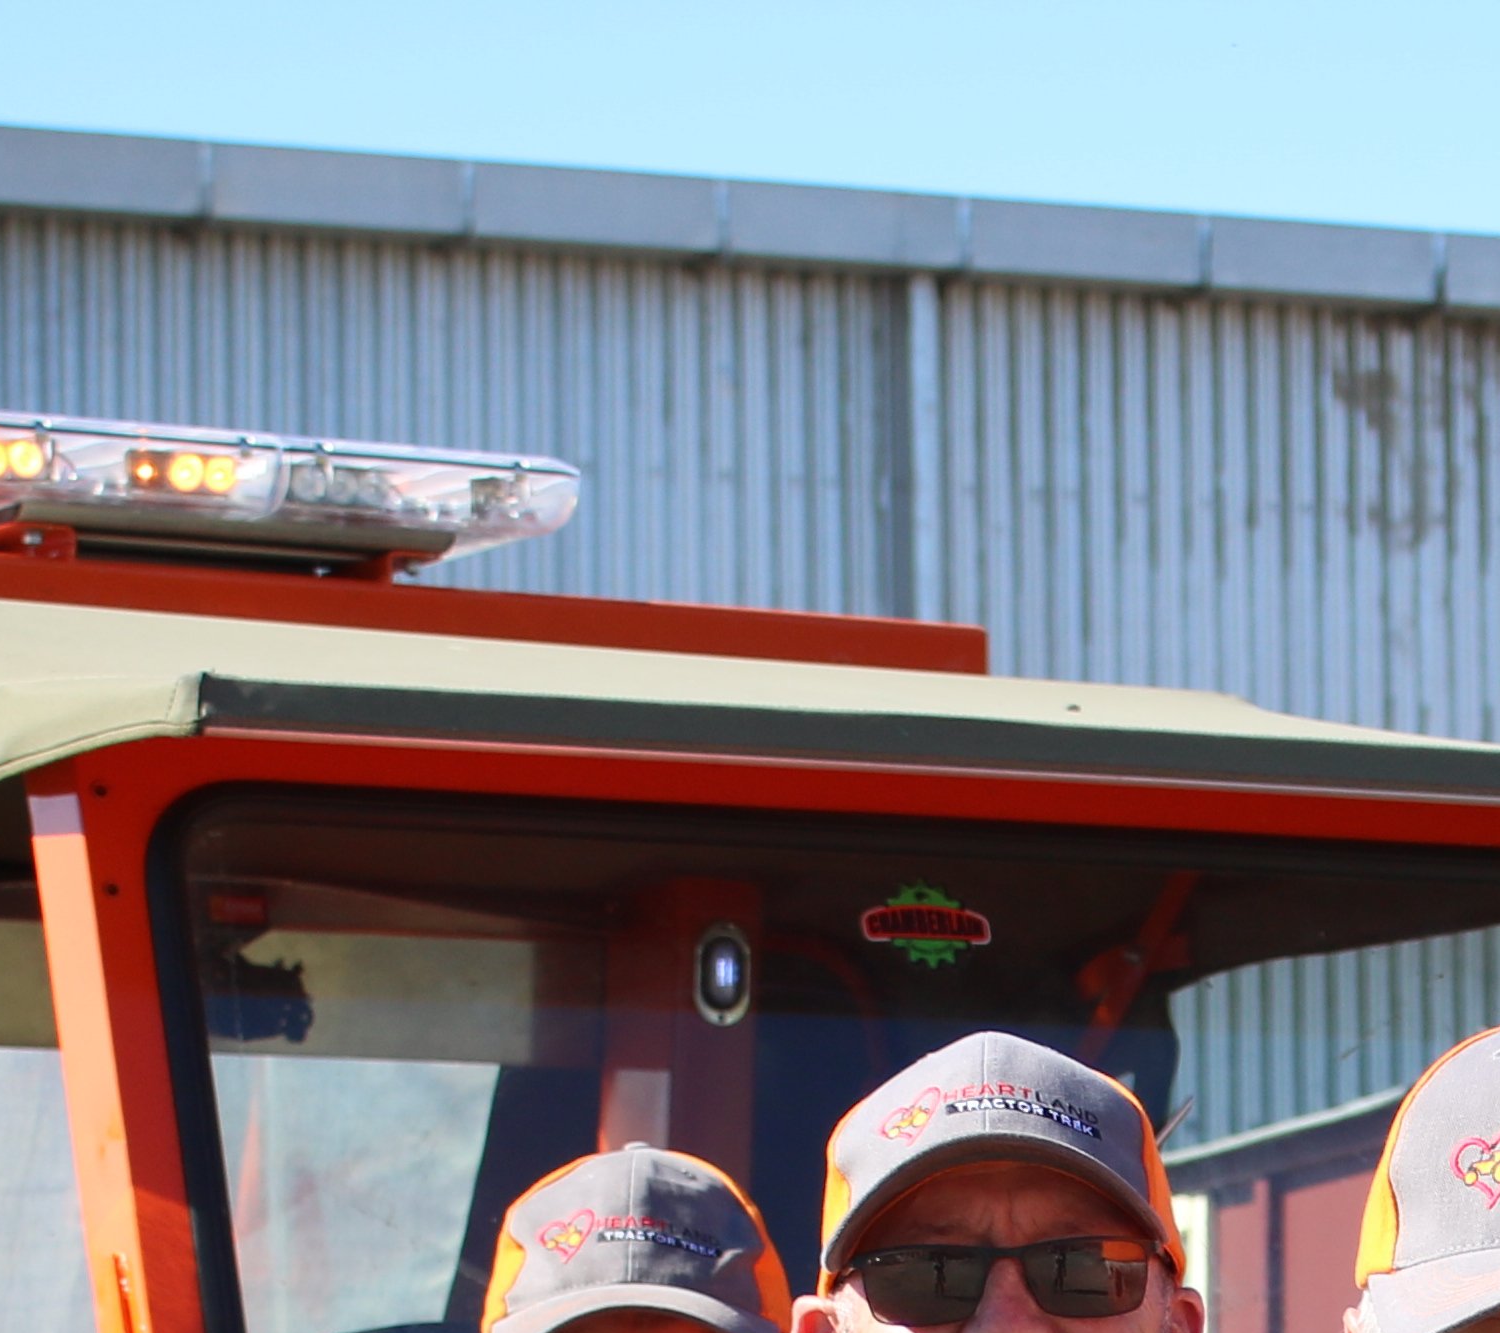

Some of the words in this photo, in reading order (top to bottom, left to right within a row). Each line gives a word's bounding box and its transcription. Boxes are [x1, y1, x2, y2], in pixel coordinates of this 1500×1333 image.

[943, 1082, 1099, 1124] HEARTLAND
[953, 1099, 1045, 1116] TRACTOR
[1048, 1110, 1095, 1137] TREK
[595, 1215, 720, 1246] HEARTLAND
[603, 1230, 677, 1247] TRACTOR
[681, 1241, 718, 1258] TREK
